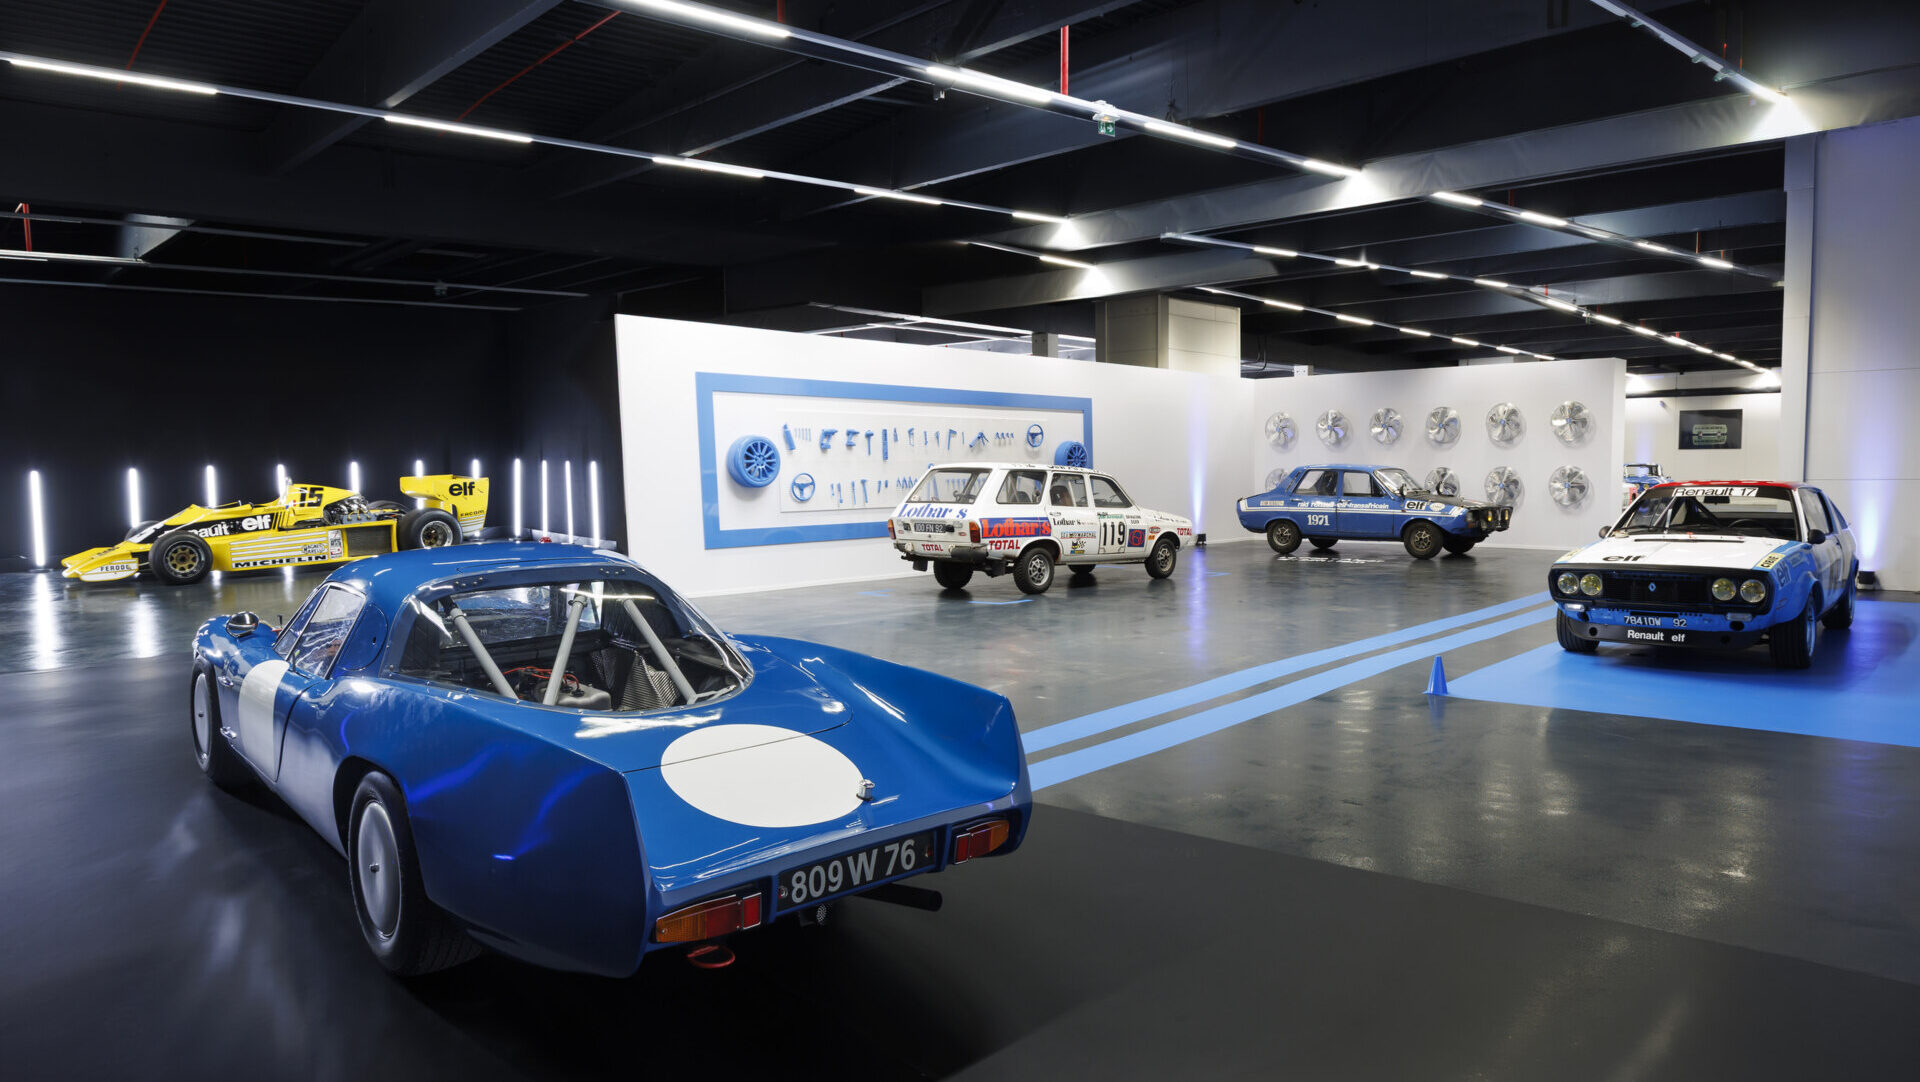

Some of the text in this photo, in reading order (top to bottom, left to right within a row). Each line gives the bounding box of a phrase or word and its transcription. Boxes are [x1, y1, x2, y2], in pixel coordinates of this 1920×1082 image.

[449, 482, 475, 496] elf
[1674, 488, 1756, 496] Renault 17
[300, 487, 324, 507] 15
[898, 504, 952, 518] Lothar
[1406, 501, 1425, 510] elf
[241, 514, 271, 531] elf
[1307, 514, 1330, 526] 1971
[982, 517, 1038, 538] Lothar
[1103, 521, 1125, 546] 119
[1177, 527, 1192, 536] TOTAL
[988, 540, 1020, 550] TOTAL
[235, 555, 327, 568] MICHELIN
[1672, 618, 1687, 628] 92
[1627, 629, 1686, 642] Renault elf
[791, 839, 916, 903] 809 W 76
